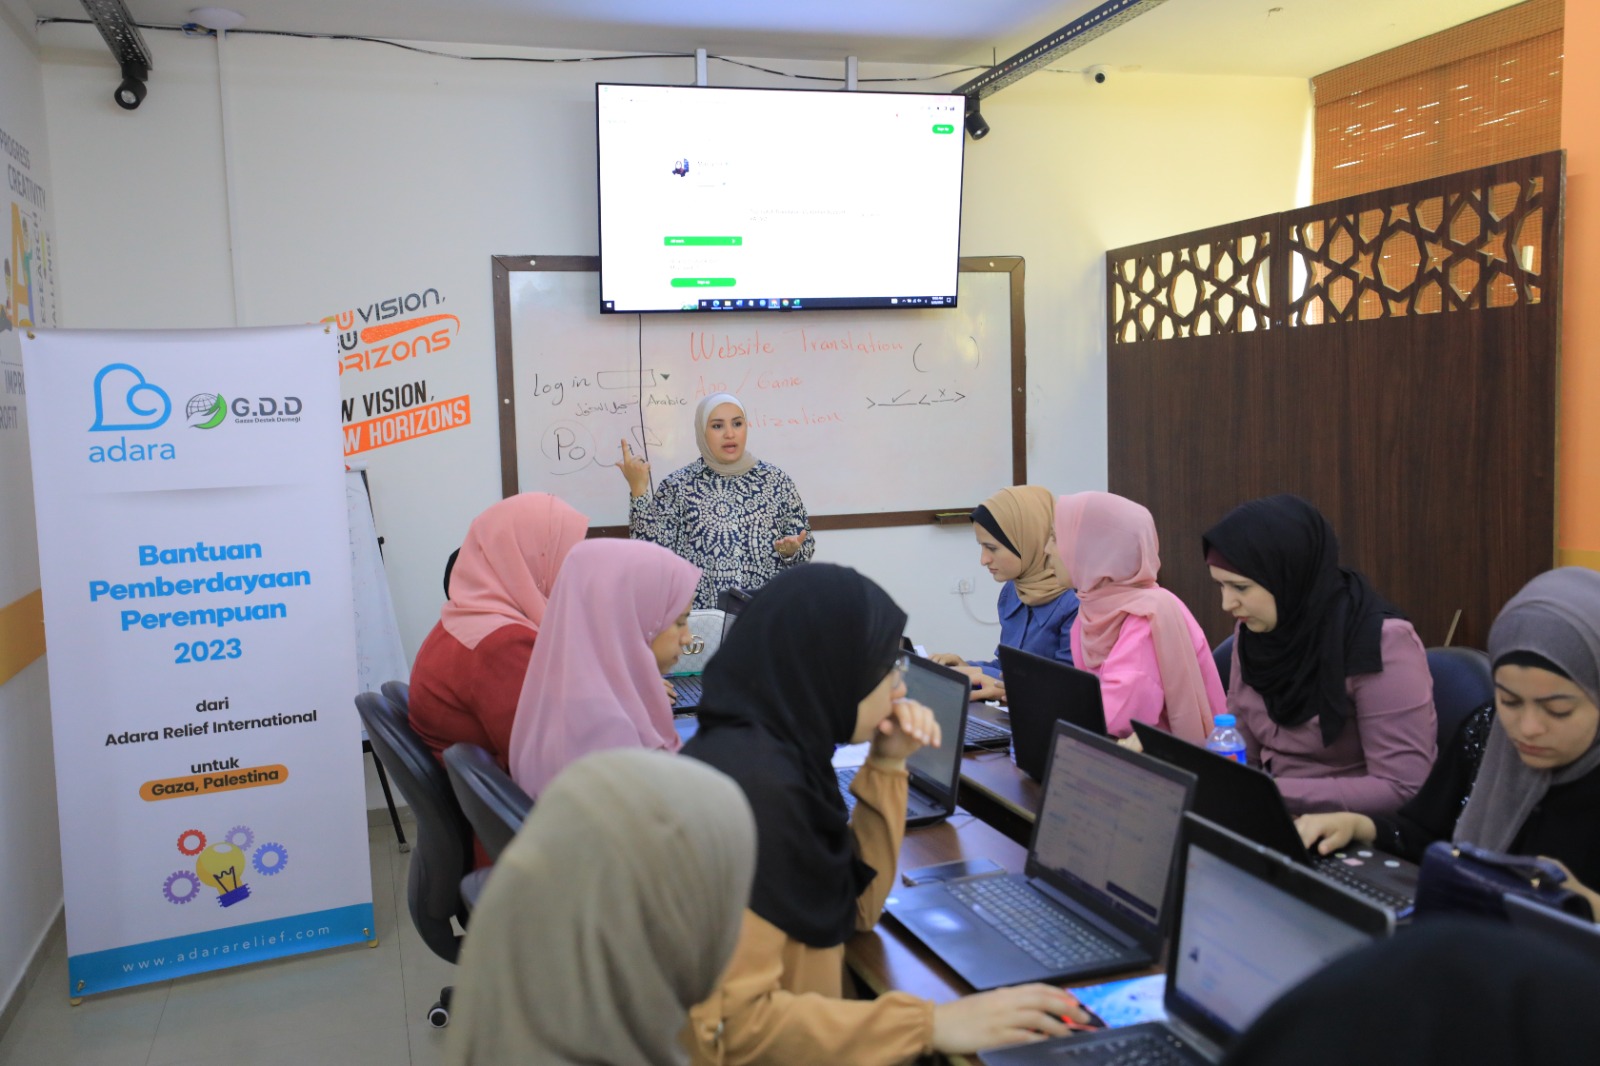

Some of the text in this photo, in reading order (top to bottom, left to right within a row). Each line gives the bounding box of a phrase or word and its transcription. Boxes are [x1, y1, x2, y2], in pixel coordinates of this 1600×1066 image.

[8, 163, 46, 212] CREATIVITY
[32, 211, 46, 325] ESEARCH
[357, 288, 446, 323] VISION,
[338, 328, 451, 376] RIZONS
[690, 324, 904, 362] Website Translation
[362, 380, 435, 417] VISION,
[533, 373, 565, 406] Log
[647, 394, 688, 406] Arabic
[231, 396, 303, 417] G.D.D
[369, 400, 467, 447] HORIZONS
[88, 436, 176, 463] adara
[138, 541, 262, 566] Bantuan
[89, 569, 311, 602] Pemberdayaan
[120, 602, 287, 631] Perempuan
[173, 637, 243, 664] 2023
[195, 696, 230, 713] dari
[105, 709, 318, 747] Adara Relief International
[151, 767, 279, 796] Gaza, Palestina
[190, 756, 240, 774] untuk
[122, 925, 331, 973] www.adararelief.com
